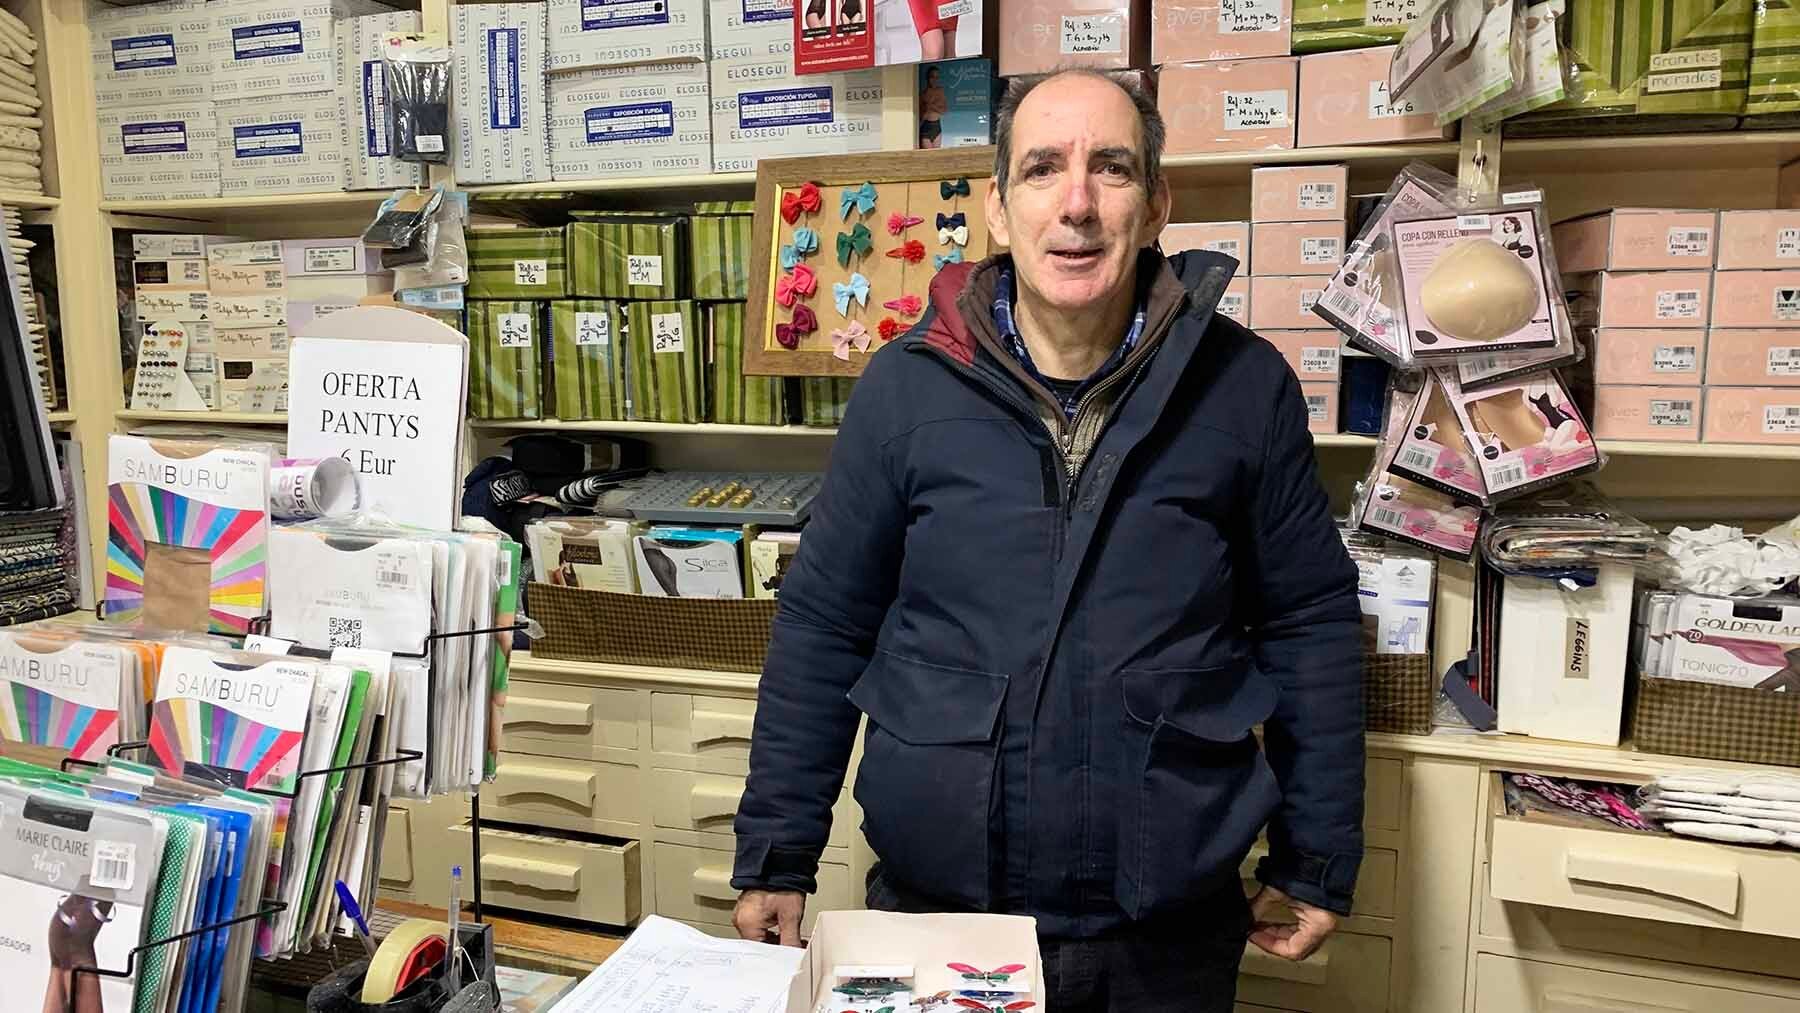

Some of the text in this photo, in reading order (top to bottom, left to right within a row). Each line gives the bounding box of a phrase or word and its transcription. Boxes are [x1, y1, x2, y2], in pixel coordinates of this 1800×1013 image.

[728, 65, 787, 79] ELOSEGUI
[797, 93, 818, 101] TUPIDA
[730, 121, 871, 140] ELOSEGUI ELOSEGUI
[1401, 230, 1421, 242] COPA
[1422, 230, 1437, 240] CON
[322, 371, 422, 401] OFERTA
[320, 409, 420, 440] PANTYS
[124, 457, 231, 491] SAMBURU
[359, 449, 396, 476] Eur
[1688, 630, 1702, 640] 70
[1694, 617, 1766, 633] GOLDEN
[175, 672, 279, 708] SAMBURU
[16, 827, 49, 849] MARIE
[51, 835, 89, 857] CLAIRE
